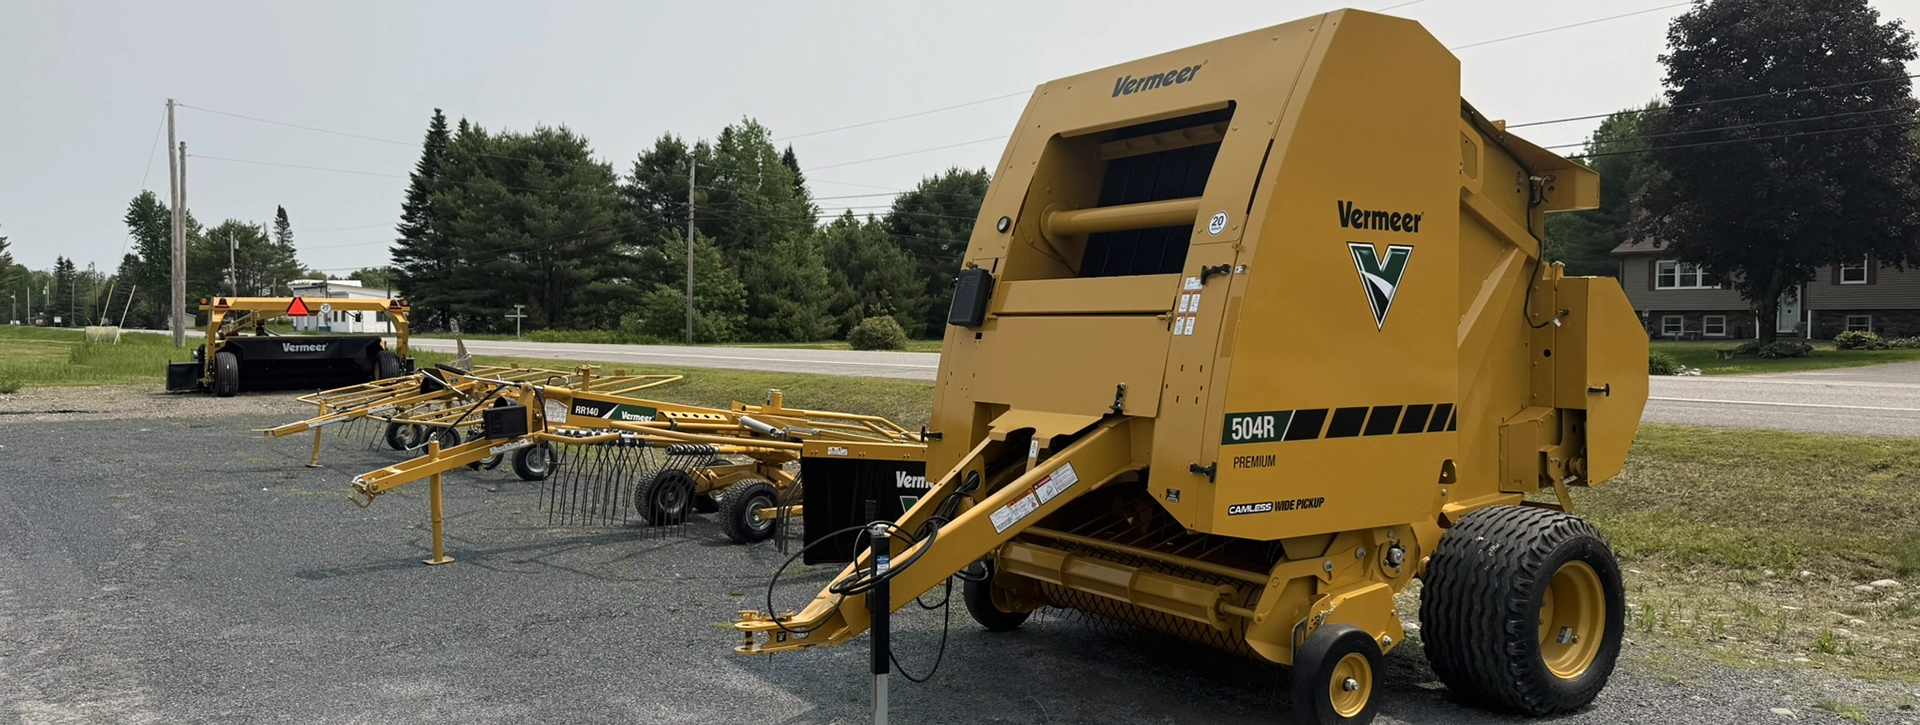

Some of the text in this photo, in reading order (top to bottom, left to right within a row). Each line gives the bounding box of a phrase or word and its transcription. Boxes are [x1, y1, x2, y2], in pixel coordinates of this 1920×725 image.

[1112, 64, 1202, 98] Vermeer
[1211, 215, 1224, 227] 20
[1337, 200, 1422, 233] Vermeer
[282, 342, 327, 352] Vermeer
[575, 405, 599, 416] RR140
[1231, 415, 1275, 440] 504R
[1233, 455, 1276, 469] PREMIUM
[895, 471, 935, 489] Verm
[1229, 497, 1325, 515] CAMLESS WIDE PICKUP
